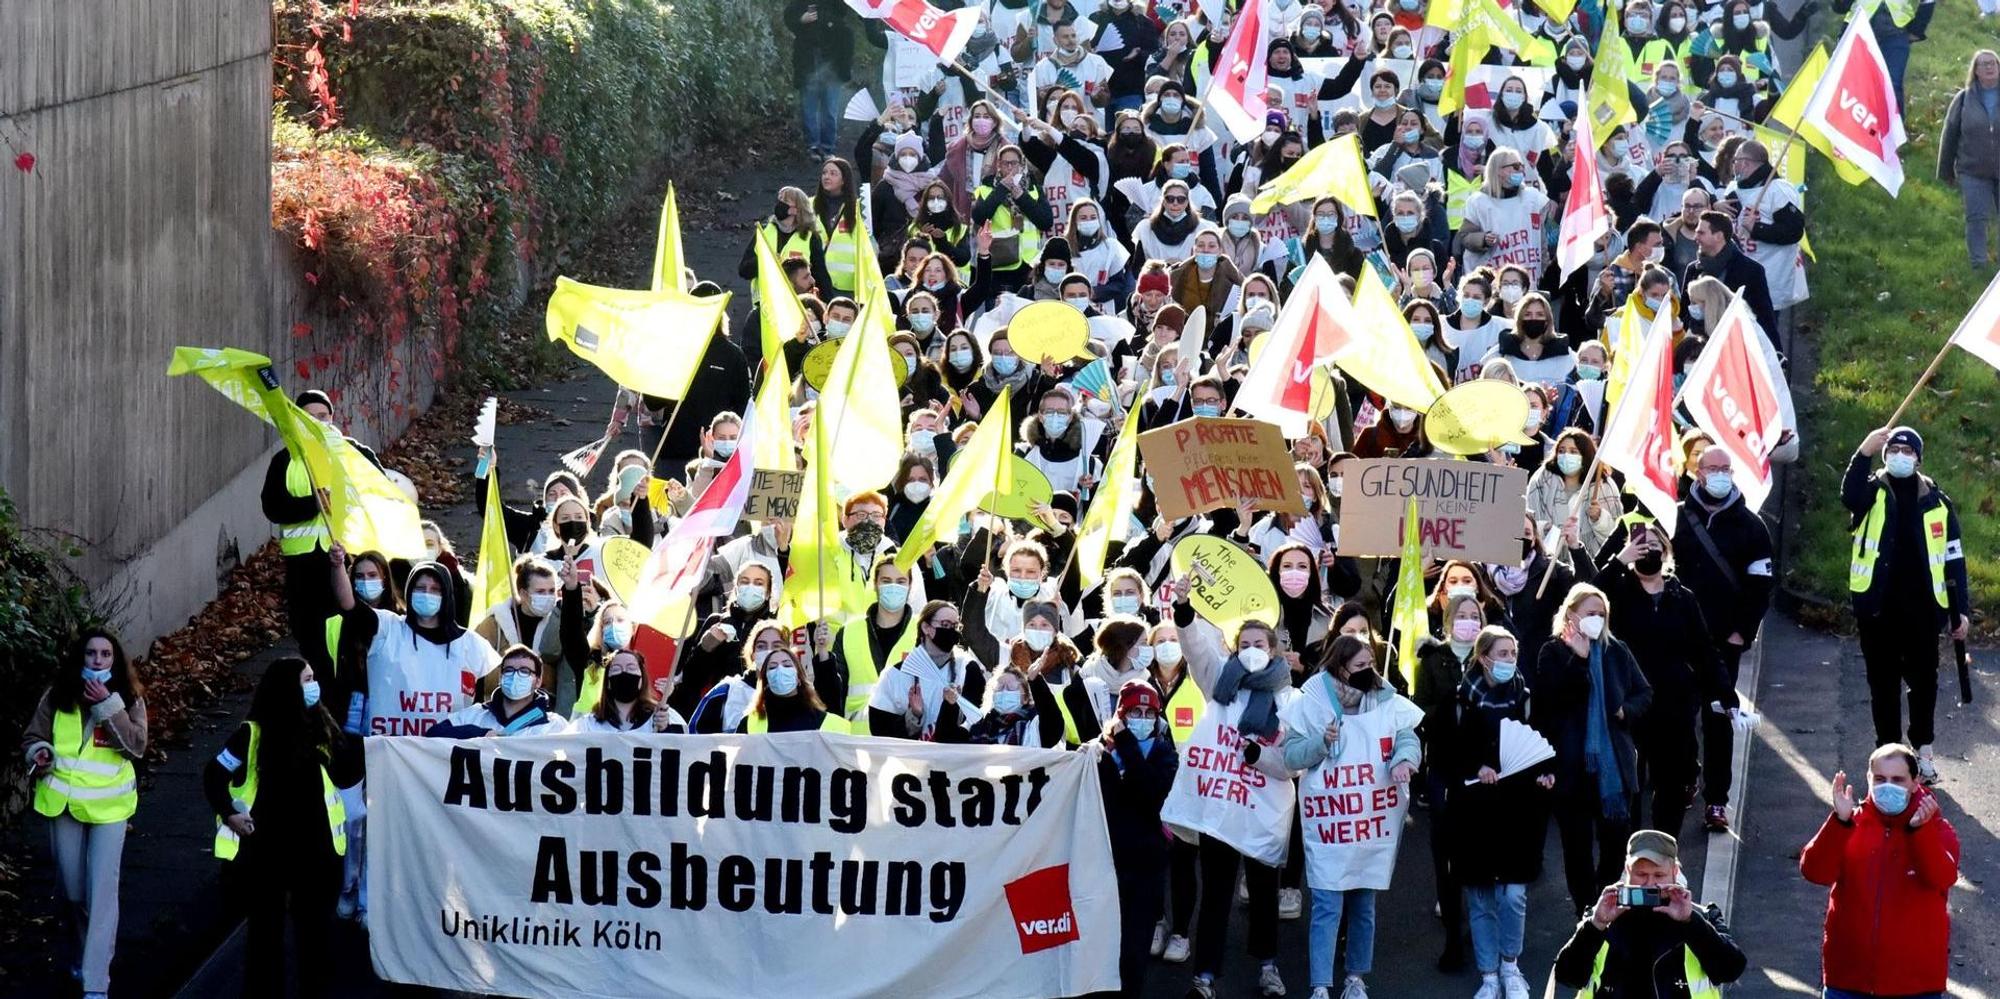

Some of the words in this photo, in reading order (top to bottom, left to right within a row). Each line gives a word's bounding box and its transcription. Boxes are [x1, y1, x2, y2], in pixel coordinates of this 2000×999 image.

[1179, 465, 1286, 510] MENSCHEN
[1360, 464, 1504, 504] GESUNDHEIT
[1402, 500, 1429, 514] IT
[1435, 501, 1477, 514] KEINE
[1191, 544, 1235, 596] Working
[1216, 544, 1237, 569] The
[1190, 574, 1228, 611] Dead
[400, 690, 452, 713] WIR
[443, 745, 868, 834] Ausbildung
[891, 766, 1050, 828] statt
[1323, 763, 1375, 789] WIR
[1304, 792, 1363, 818] SIND
[1372, 786, 1398, 811] ES
[1317, 815, 1390, 844] WERT.
[530, 835, 967, 923] Ausbeutung
[440, 908, 582, 948] Uniklinik
[593, 920, 662, 951] Köln
[1020, 912, 1071, 935] ver.di
